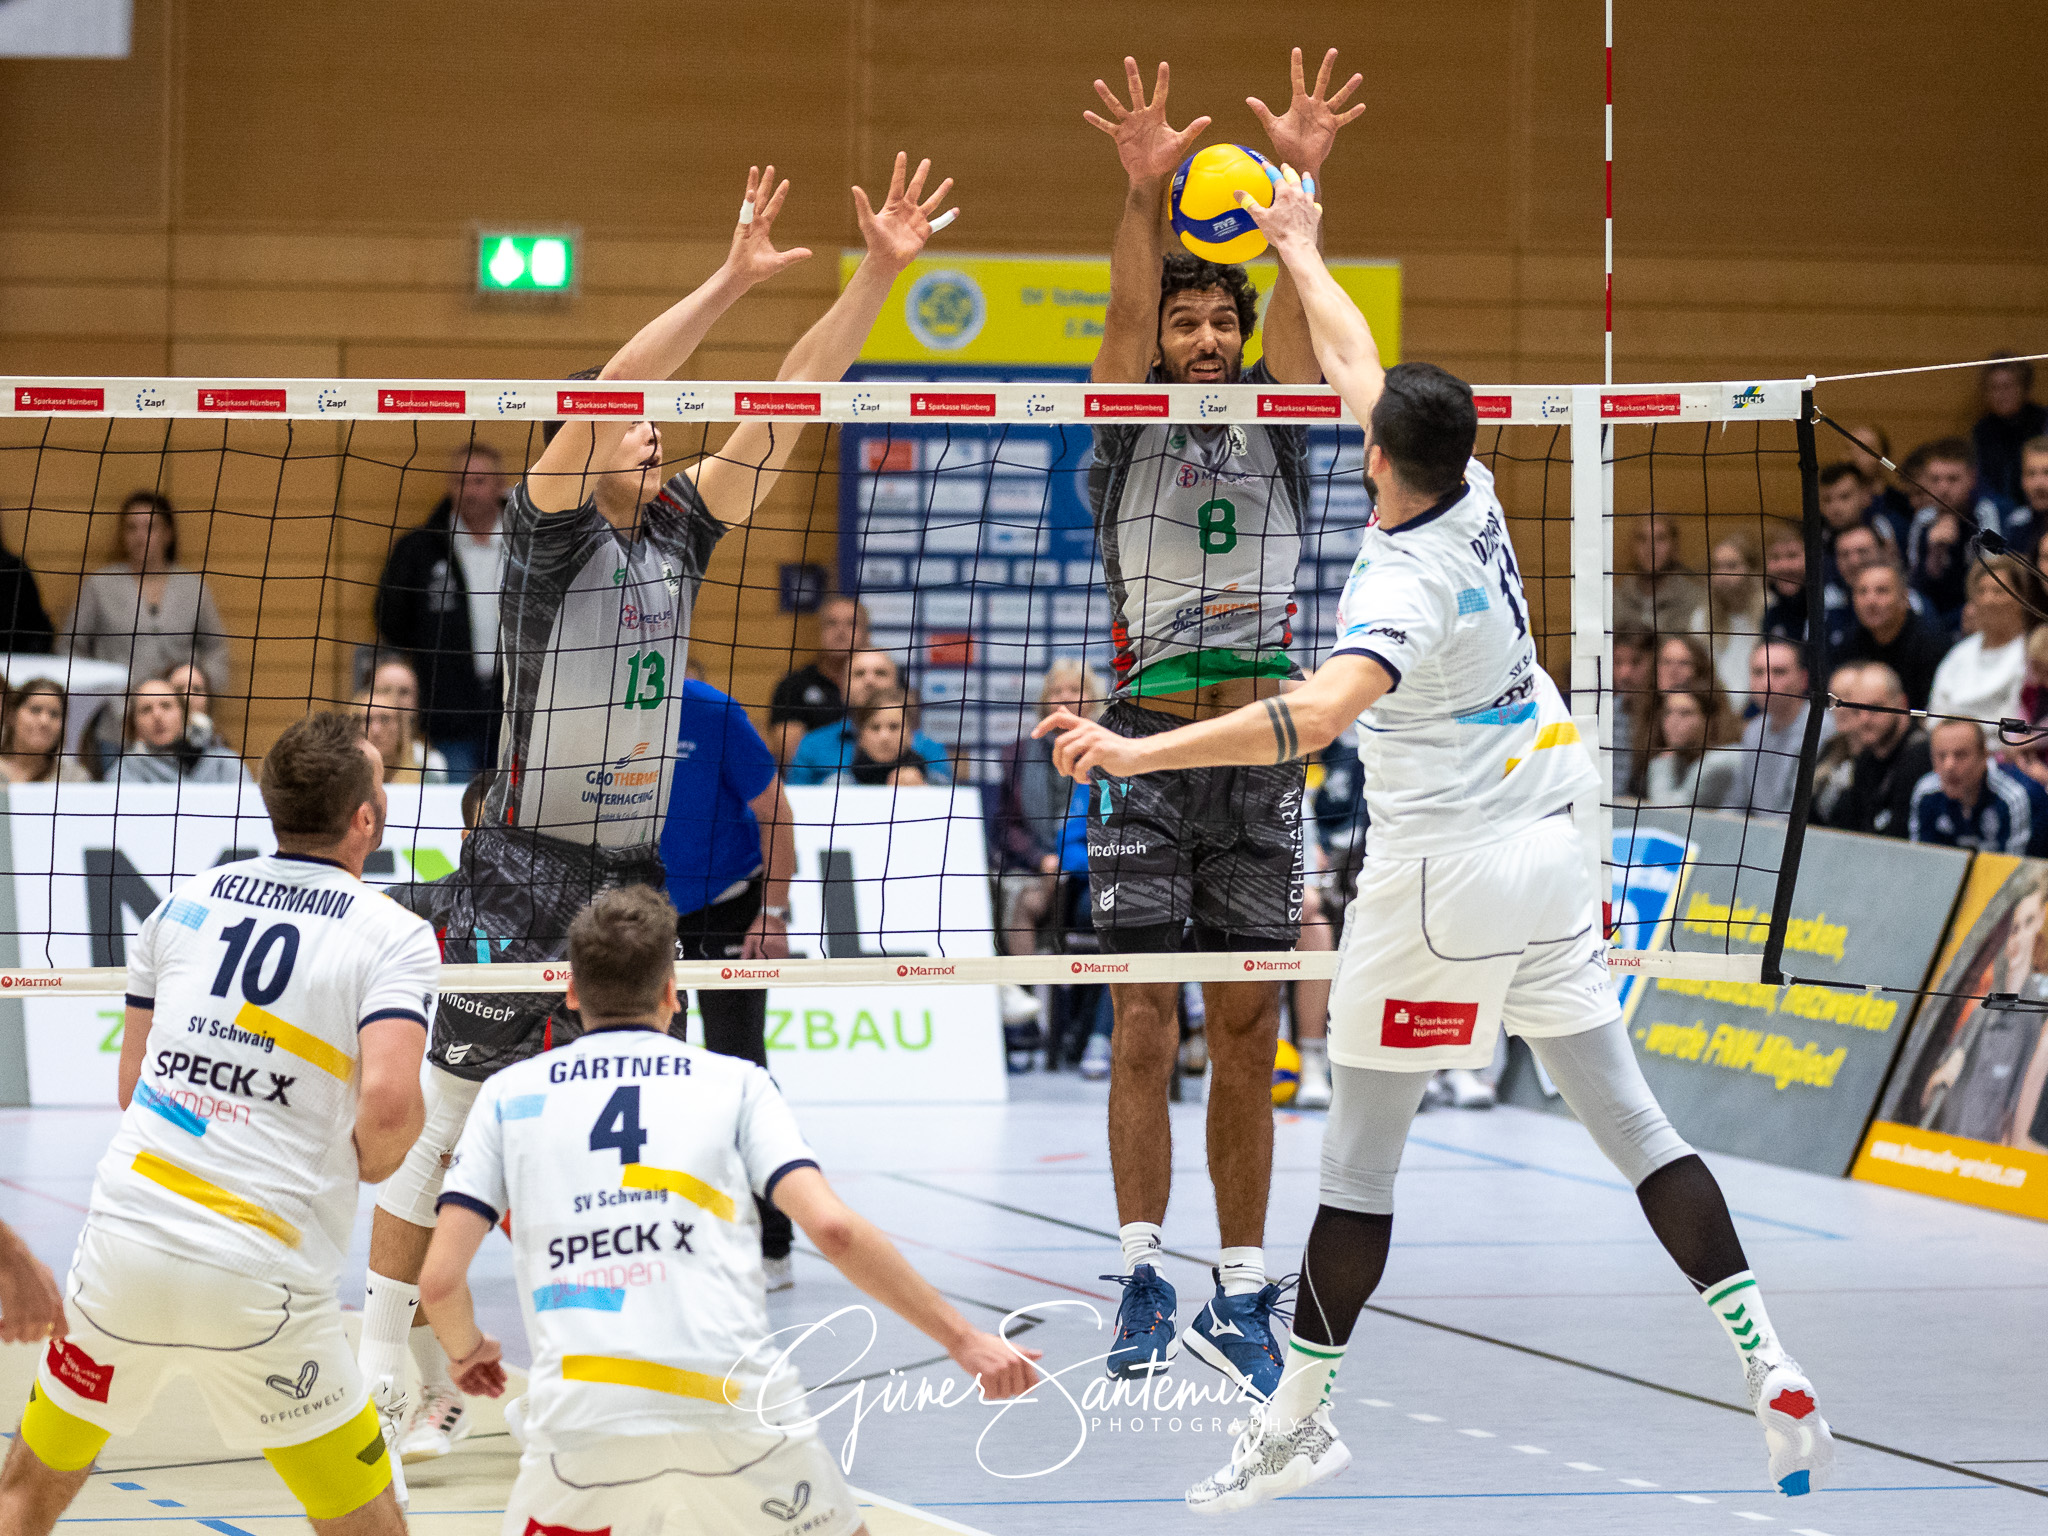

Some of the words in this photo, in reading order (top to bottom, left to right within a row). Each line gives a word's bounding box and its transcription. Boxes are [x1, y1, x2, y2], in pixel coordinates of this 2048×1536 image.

[33, 397, 65, 406] Sparkasse
[67, 397, 98, 407] Nürnberg
[145, 398, 165, 408] Zapf
[216, 398, 248, 408] Sparkasse
[249, 398, 280, 408] Nürnberg
[326, 399, 347, 408] Zapf
[396, 399, 427, 408] Sparkasse
[429, 399, 460, 409] Nürnberg
[1732, 394, 1764, 405] HUCK
[506, 401, 526, 410] Zapf
[575, 401, 607, 410] Sparkasse
[609, 400, 638, 410] Nürnberg
[684, 402, 704, 411] Zapf
[753, 402, 783, 411] Sparkasse
[785, 401, 815, 411] Nürnberg
[860, 403, 880, 412] Zapf
[928, 403, 959, 411] Sparkasse
[960, 403, 990, 412] Nürnberg
[1035, 404, 1054, 413] Zapf
[1101, 403, 1132, 412] Sparkasse
[1134, 403, 1163, 413] Nürnberg
[1207, 404, 1227, 414] Zapf
[1274, 404, 1304, 413] Sparkasse
[1306, 404, 1336, 413] Nürnberg
[1477, 404, 1507, 413] Nürnberg
[1550, 405, 1569, 414] Zapf
[1615, 403, 1645, 412] Sparkasse
[1197, 497, 1238, 554] 8
[623, 649, 666, 710] 13
[210, 874, 355, 919] KELLERMANN
[210, 917, 300, 1006] 10
[1256, 961, 1301, 970] Marmot
[1607, 957, 1641, 967] armot
[909, 966, 955, 976] Marmot
[1084, 963, 1129, 972] Marmot
[734, 969, 780, 978] Marmot
[14, 977, 62, 987] Marmot
[1414, 1015, 1465, 1027] Sparkasse
[188, 1016, 207, 1034] SV
[209, 1020, 276, 1053] Schwaig
[687, 1009, 932, 1051] ZBAU
[1413, 1027, 1460, 1037] Nürnberg
[154, 1050, 259, 1097] SPECK
[550, 1054, 691, 1084] GÄRTNER
[589, 1085, 647, 1165] 4
[574, 1194, 592, 1213] SV
[598, 1184, 668, 1207] Schwaig
[548, 1222, 661, 1269] SPECK
